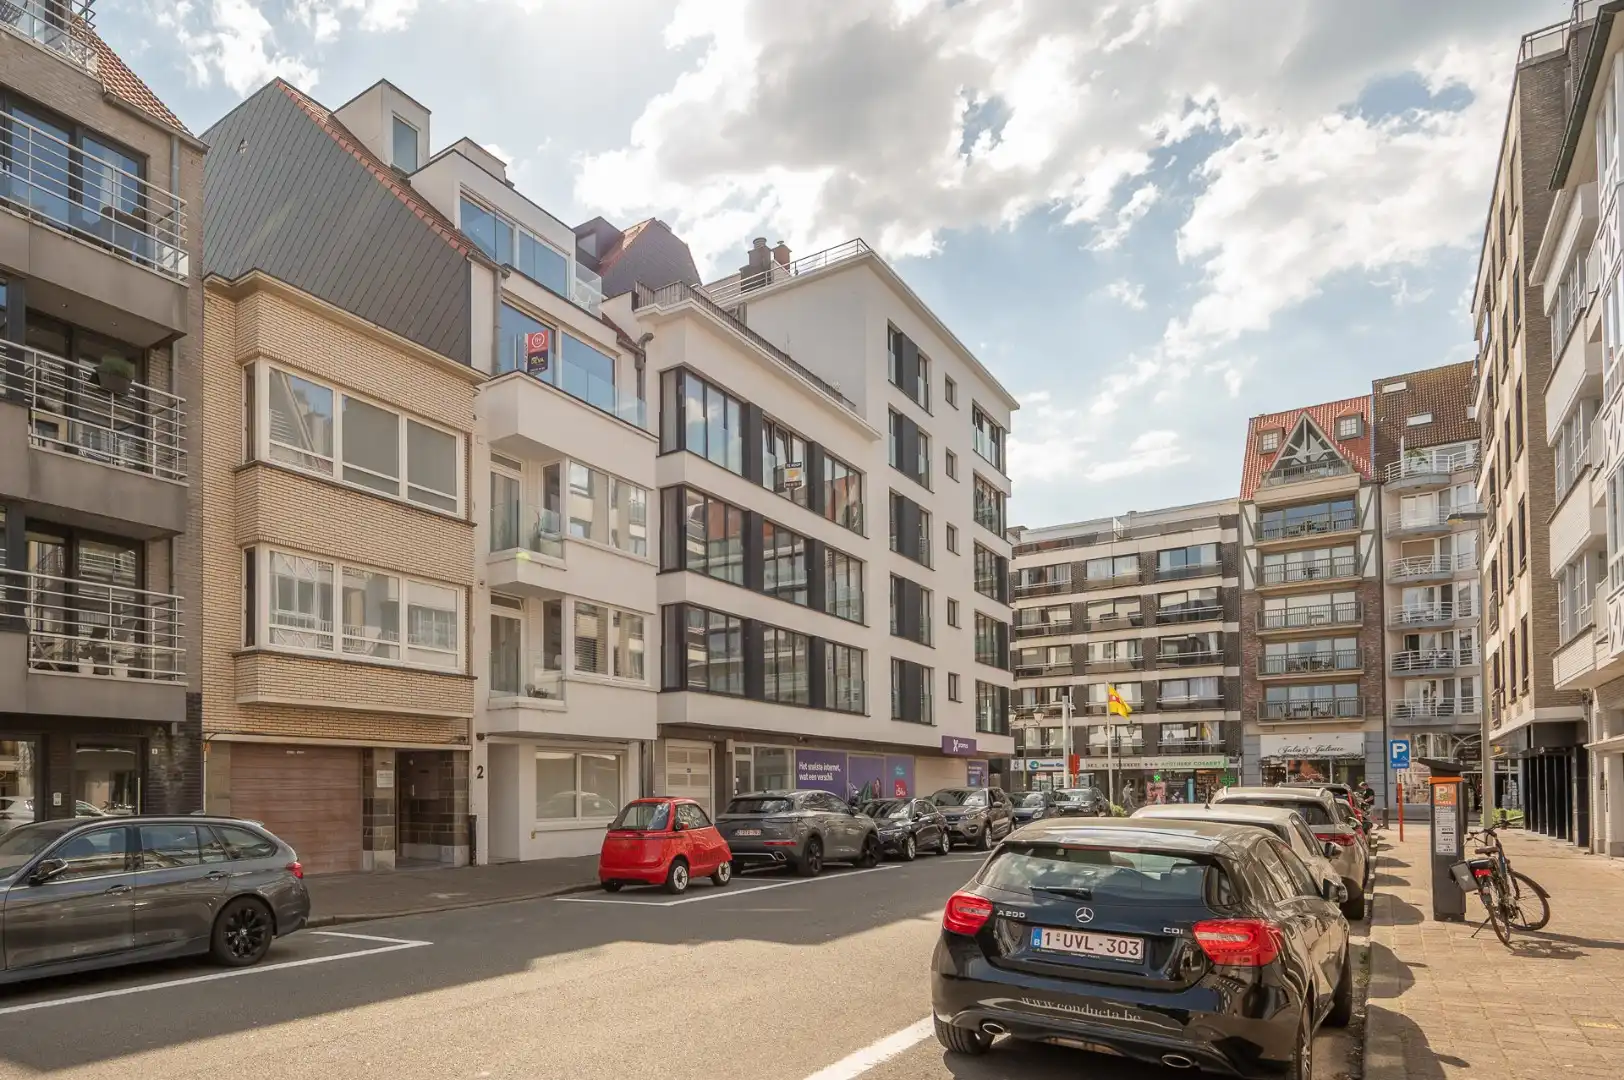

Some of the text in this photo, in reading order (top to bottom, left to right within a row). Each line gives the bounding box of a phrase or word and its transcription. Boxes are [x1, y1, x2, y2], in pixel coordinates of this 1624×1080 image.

[1392, 743, 1407, 758] P
[476, 765, 484, 779] 2
[799, 761, 808, 770] Het
[1436, 786, 1448, 800] P
[1163, 926, 1184, 935] CDI
[1034, 938, 1040, 946] B
[1020, 997, 1141, 1020] www.conducta.be
